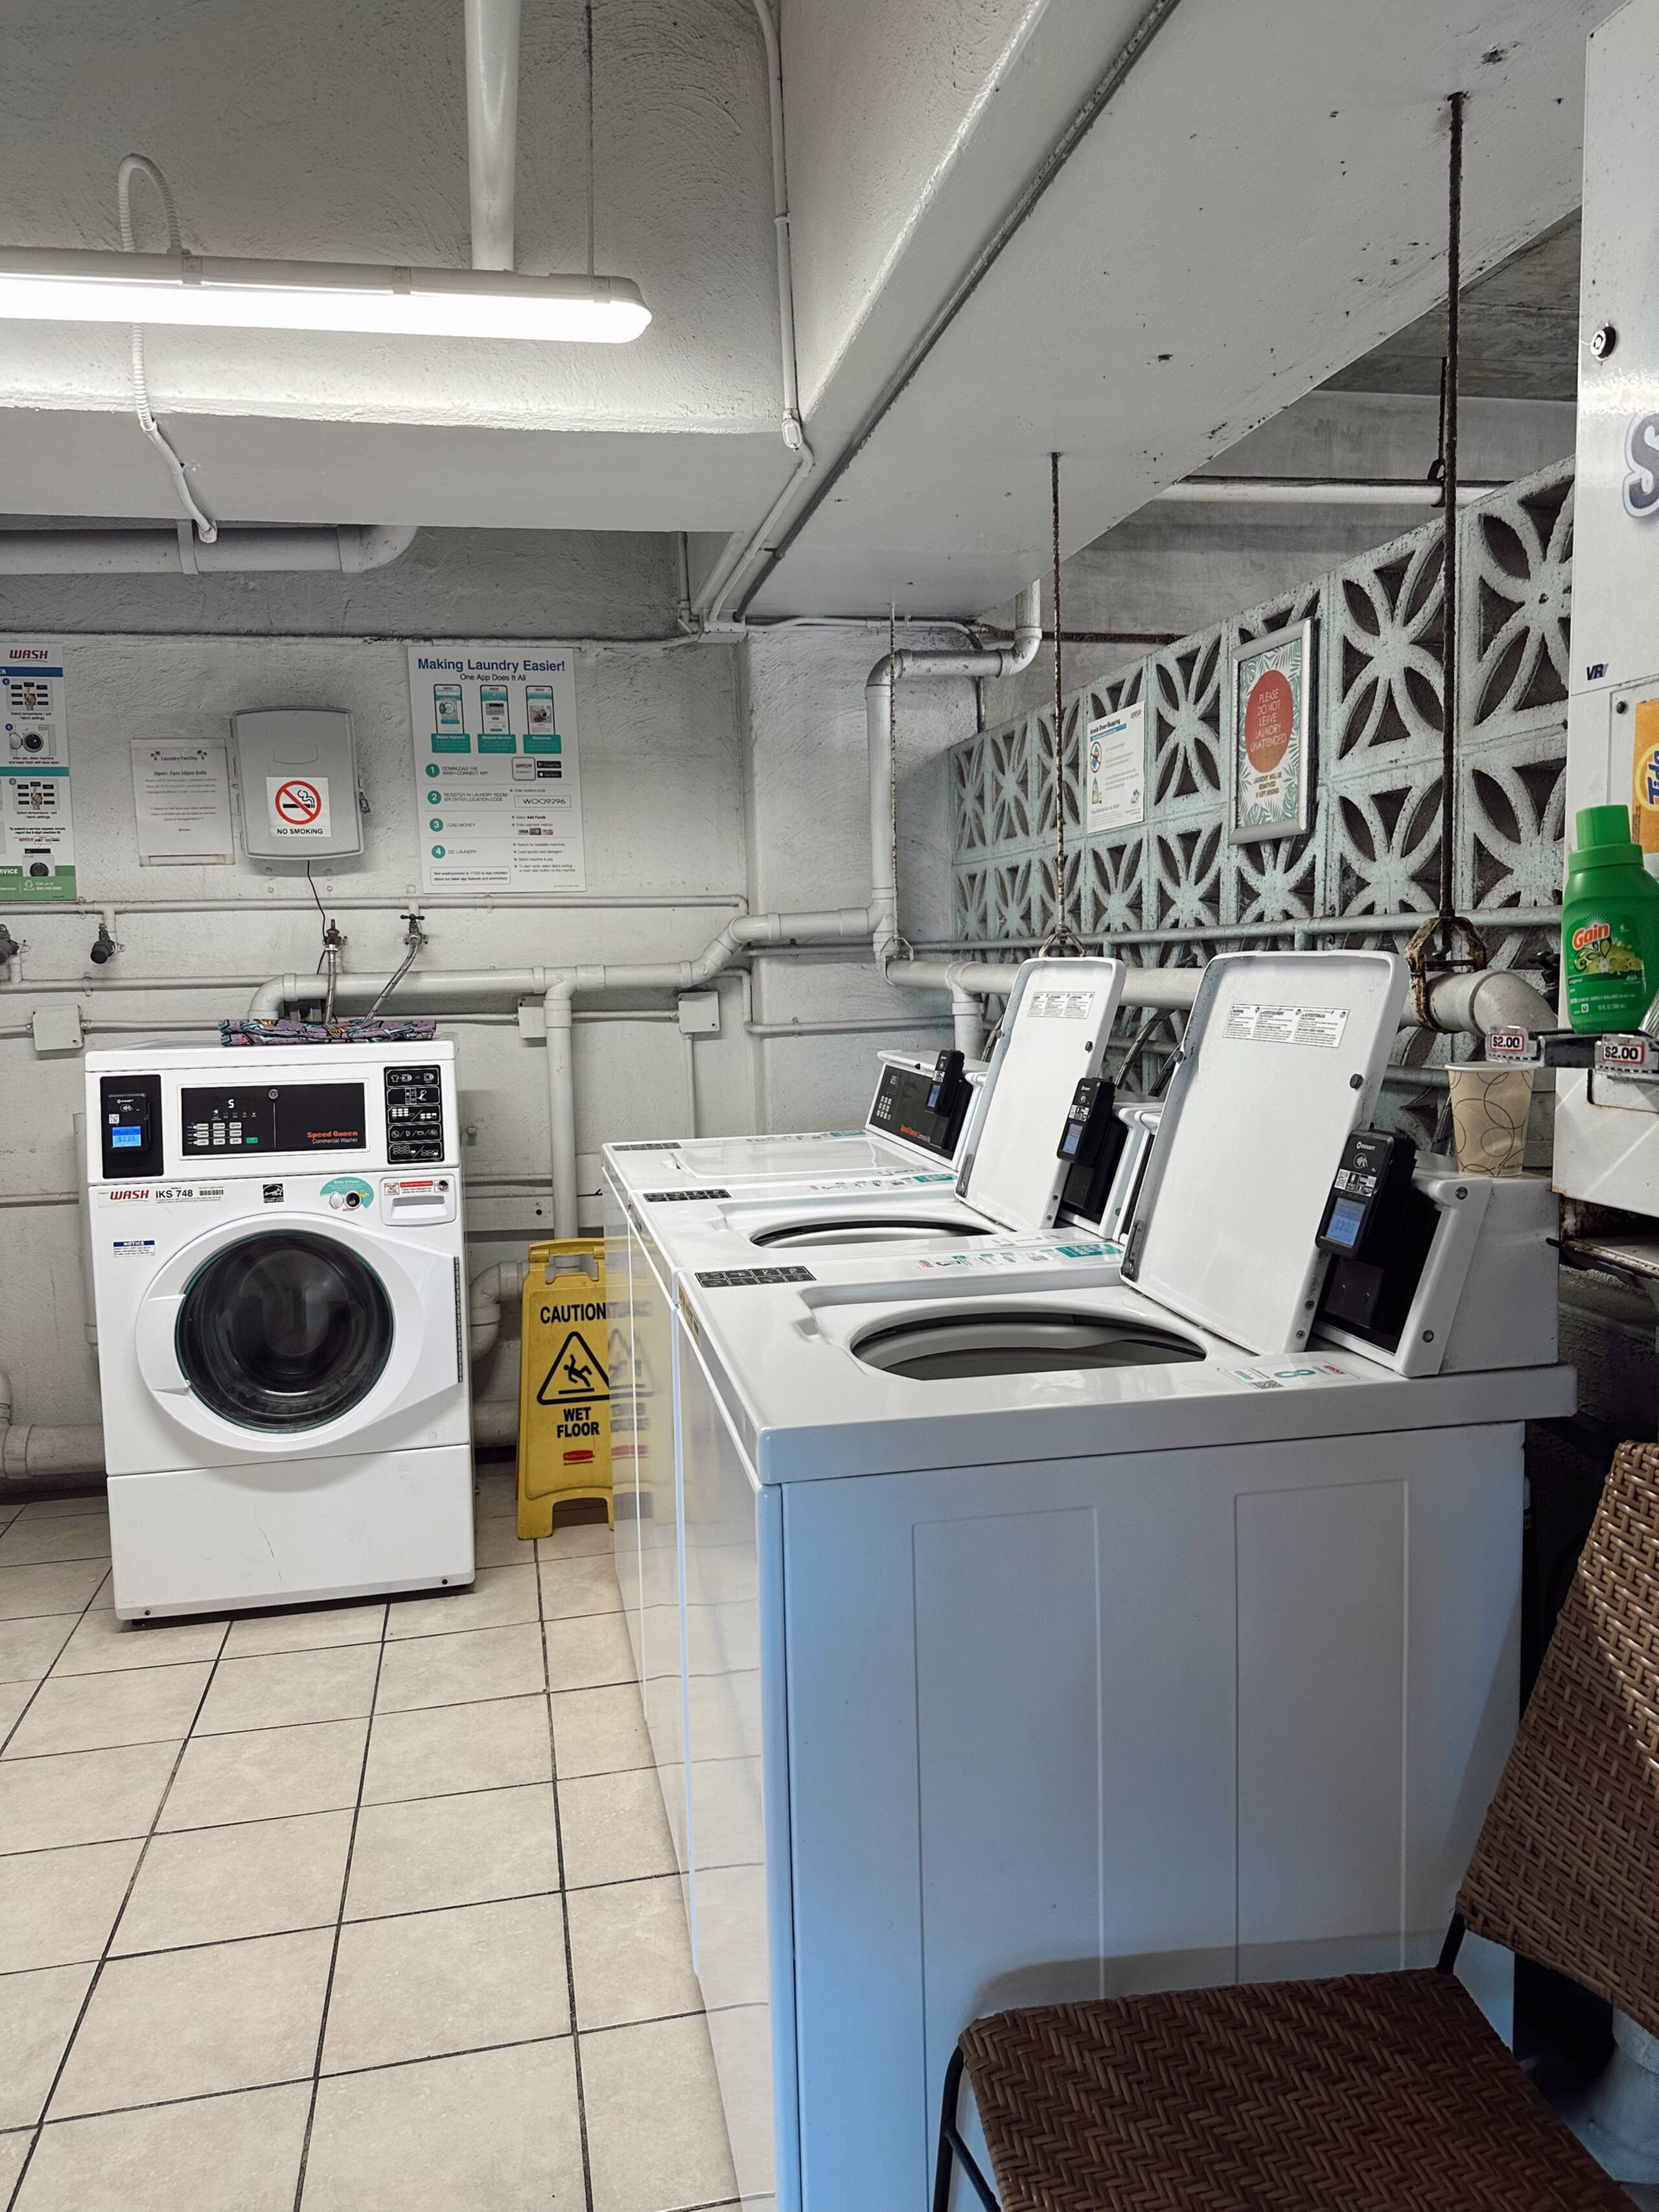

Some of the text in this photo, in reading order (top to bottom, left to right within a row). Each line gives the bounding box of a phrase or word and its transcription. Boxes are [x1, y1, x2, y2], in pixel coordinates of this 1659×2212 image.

[10, 650, 48, 659] WASH
[418, 658, 565, 673] Making Laundry Easier!
[1259, 688, 1279, 704] PLEASE
[1258, 699, 1281, 716] DO NOT
[1259, 712, 1277, 727] LEAVE
[1256, 723, 1281, 739] LAUNDRY
[1250, 734, 1286, 752] UNATTENDED
[1572, 923, 1610, 950] Gain
[1492, 1036, 1520, 1048] $2.00
[1605, 1047, 1638, 1060] $2.00
[110, 1190, 150, 1200] WASH
[156, 1190, 173, 1198] IKS
[540, 1302, 607, 1323] CAUTION
[563, 1407, 591, 1422] WET
[557, 1422, 600, 1438] FLOOR
